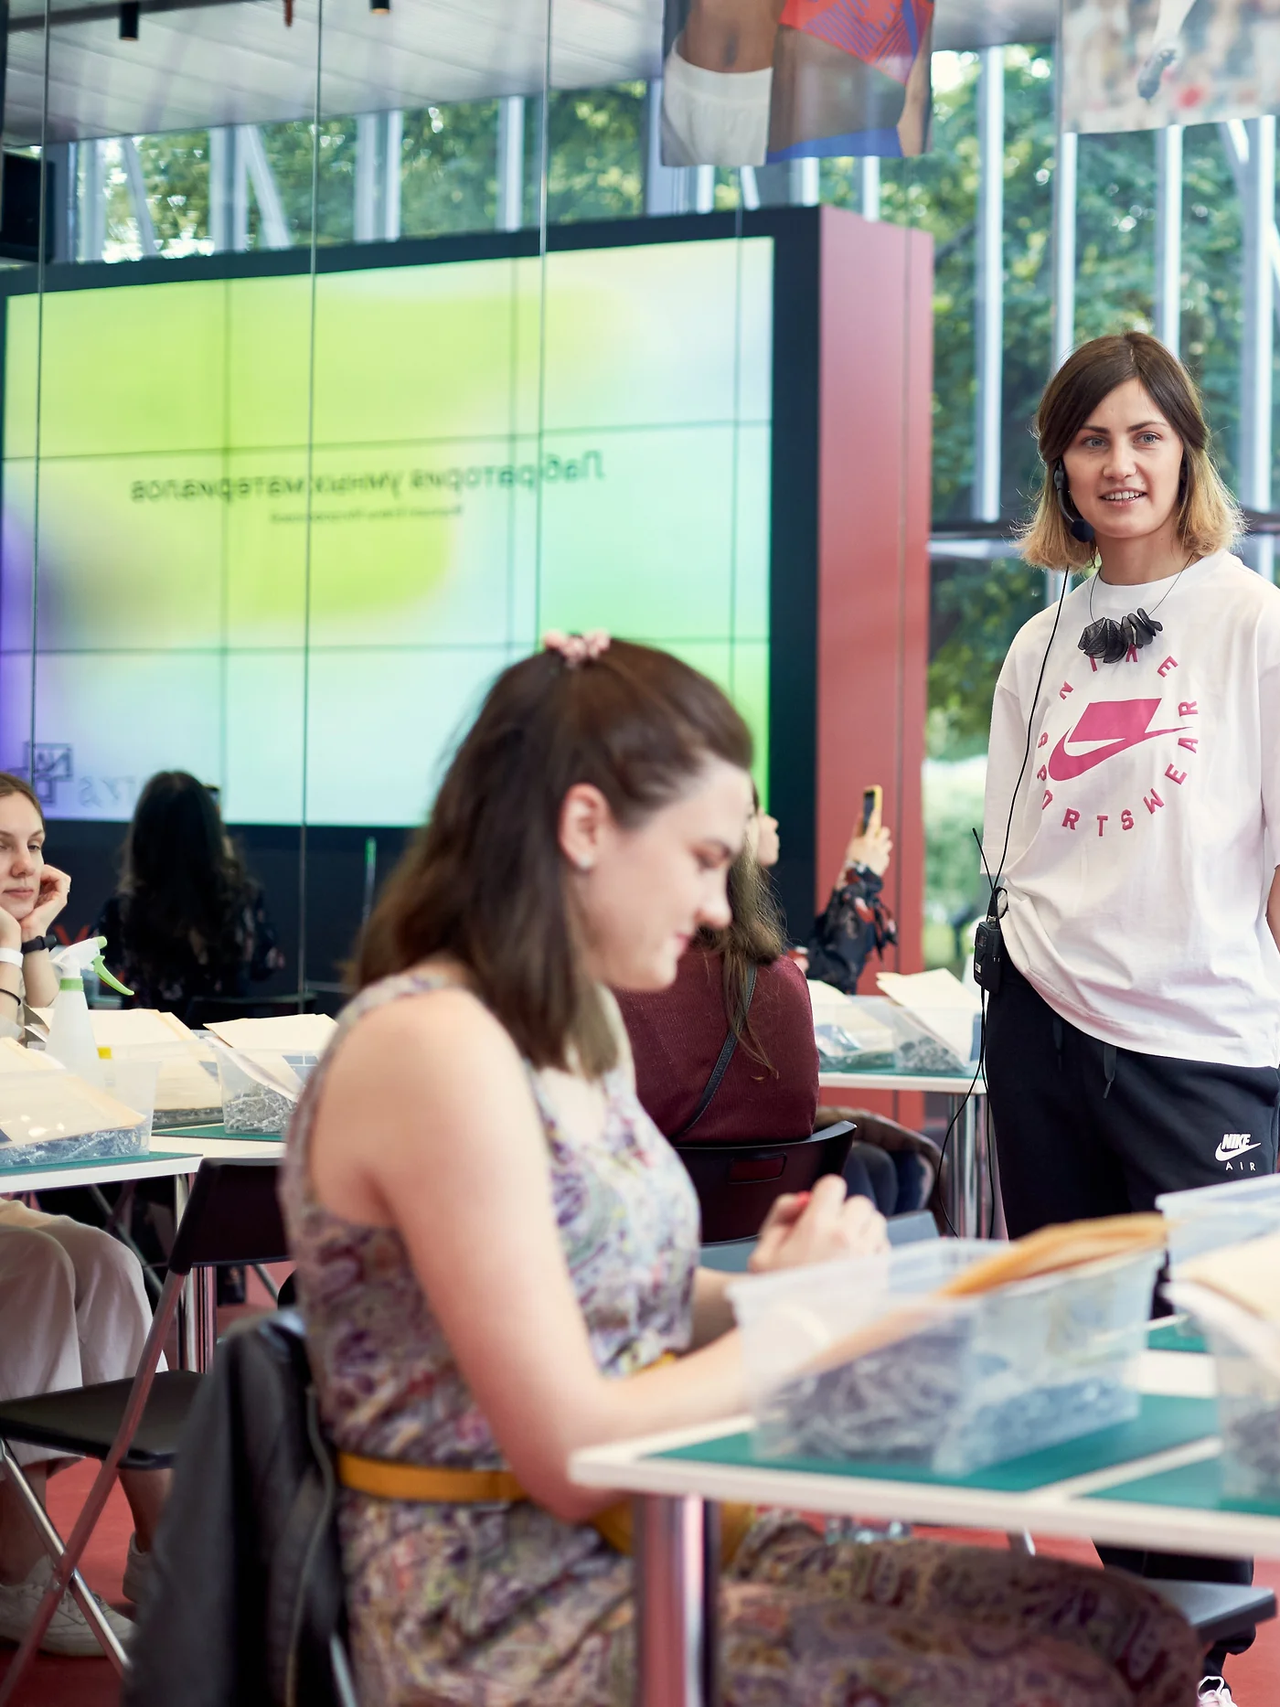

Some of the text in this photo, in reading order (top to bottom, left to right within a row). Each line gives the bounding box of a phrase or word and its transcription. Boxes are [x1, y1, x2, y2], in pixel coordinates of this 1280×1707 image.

[1037, 701, 1199, 837] SPORTSWEAR
[1221, 1134, 1251, 1149] NIKE
[1225, 1162, 1256, 1171] AIR
